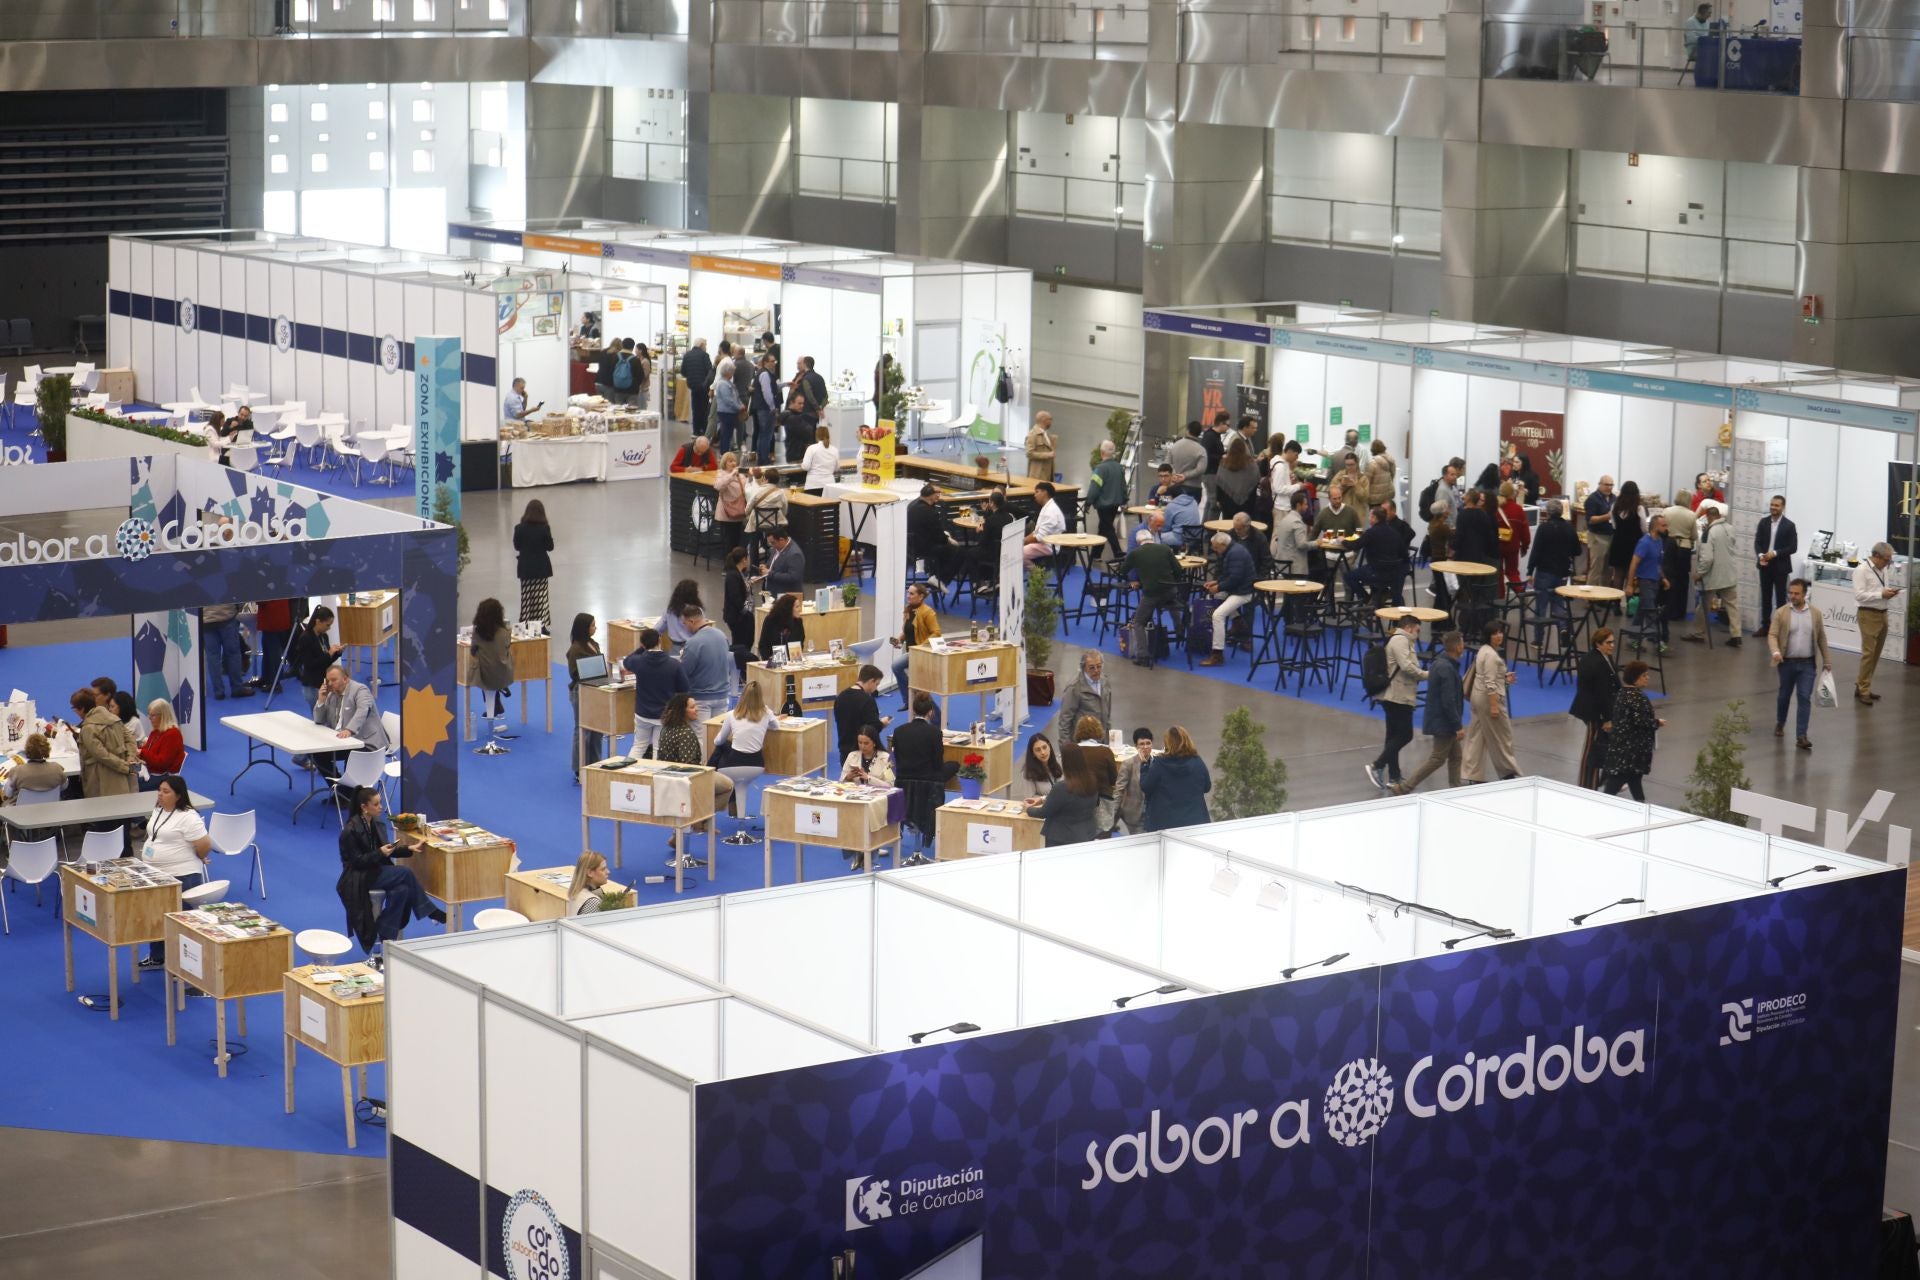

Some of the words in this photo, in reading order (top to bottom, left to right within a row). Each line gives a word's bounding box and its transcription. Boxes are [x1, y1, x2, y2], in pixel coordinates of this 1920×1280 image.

[420, 374, 429, 417] ZONA
[1511, 426, 1554, 439] MONTEOLIVA
[420, 421, 429, 519] EXHIBICIONE
[85, 535, 110, 557] a
[161, 513, 308, 550] Córdoba
[1758, 993, 1806, 1014] IPRODECO
[1082, 1109, 1258, 1190] sabor
[1269, 1098, 1311, 1149] a
[1404, 1025, 1645, 1117] Córdoba
[900, 1167, 983, 1196] Diputación
[900, 1200, 918, 1215] de
[923, 1187, 984, 1210] Córdoba
[538, 1249, 560, 1277] do
